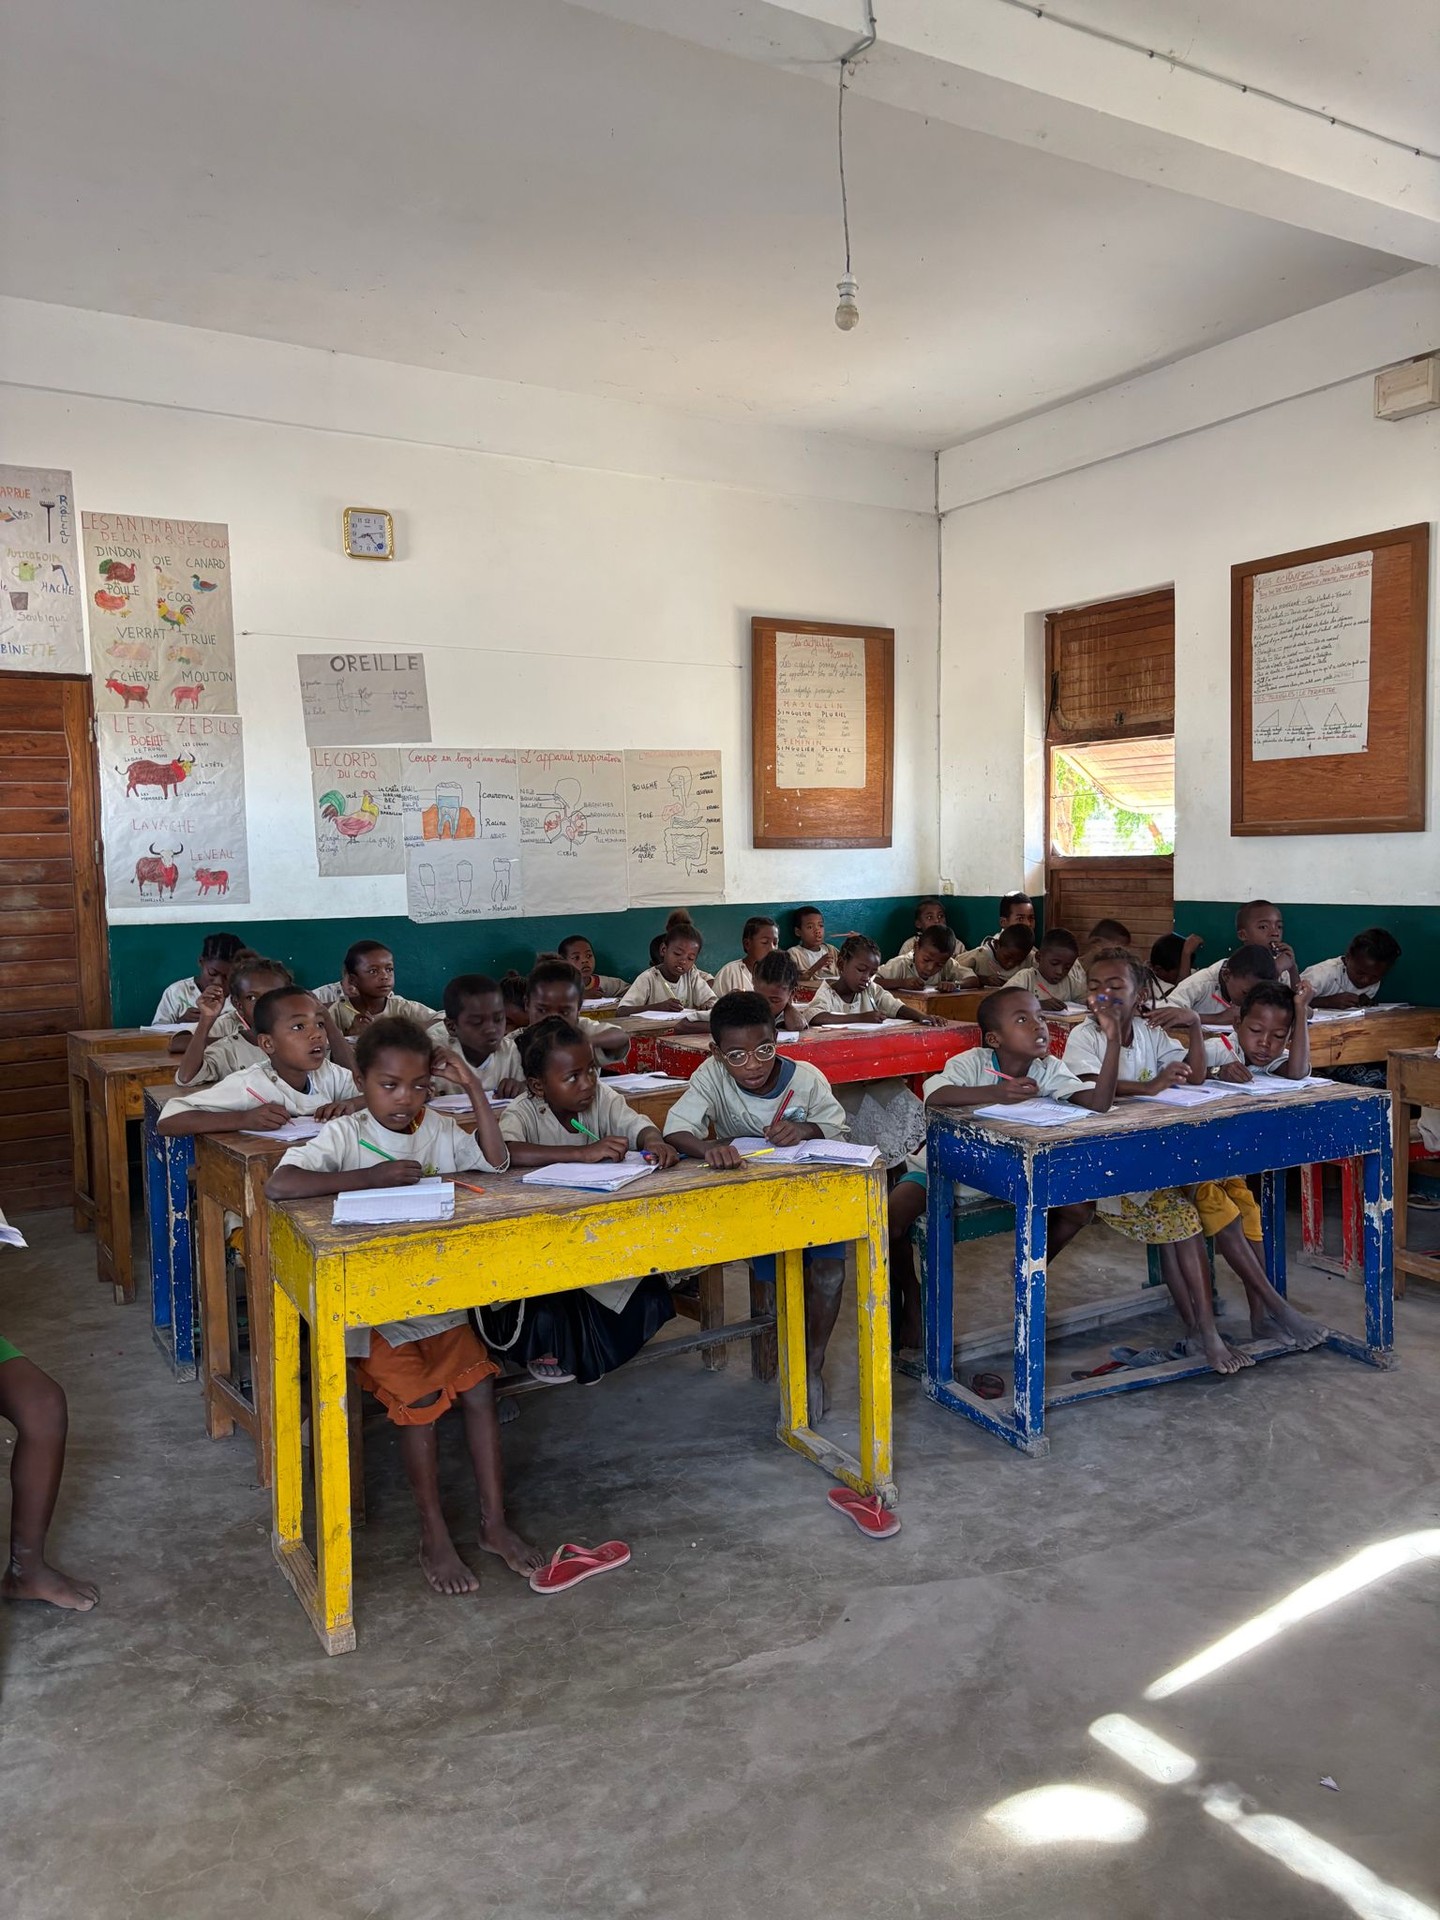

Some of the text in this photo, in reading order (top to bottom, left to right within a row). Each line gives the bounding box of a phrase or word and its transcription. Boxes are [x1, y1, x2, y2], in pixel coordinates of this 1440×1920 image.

[81, 512, 199, 535] LES ANIMAUX
[94, 546, 141, 559] DINDON
[152, 555, 172, 566] OIE
[185, 557, 226, 569] CANARD
[40, 581, 74, 595] HACHE
[104, 583, 140, 596] POULE
[167, 592, 193, 604] COQ
[116, 626, 167, 640] VERRAT
[182, 633, 216, 645] TRUIE
[330, 653, 419, 672] OREILLE
[181, 670, 233, 682] MOUTON
[113, 716, 239, 735] LES ZEBUS
[314, 748, 378, 768] LE CORPS
[408, 749, 437, 773] Coupe
[456, 753, 473, 769] long
[337, 769, 377, 780] DU COQ
[632, 780, 658, 791] BOUCHE
[639, 811, 654, 819] FOIE
[132, 818, 196, 834] LA VACHE
[204, 848, 234, 861] VEAU
